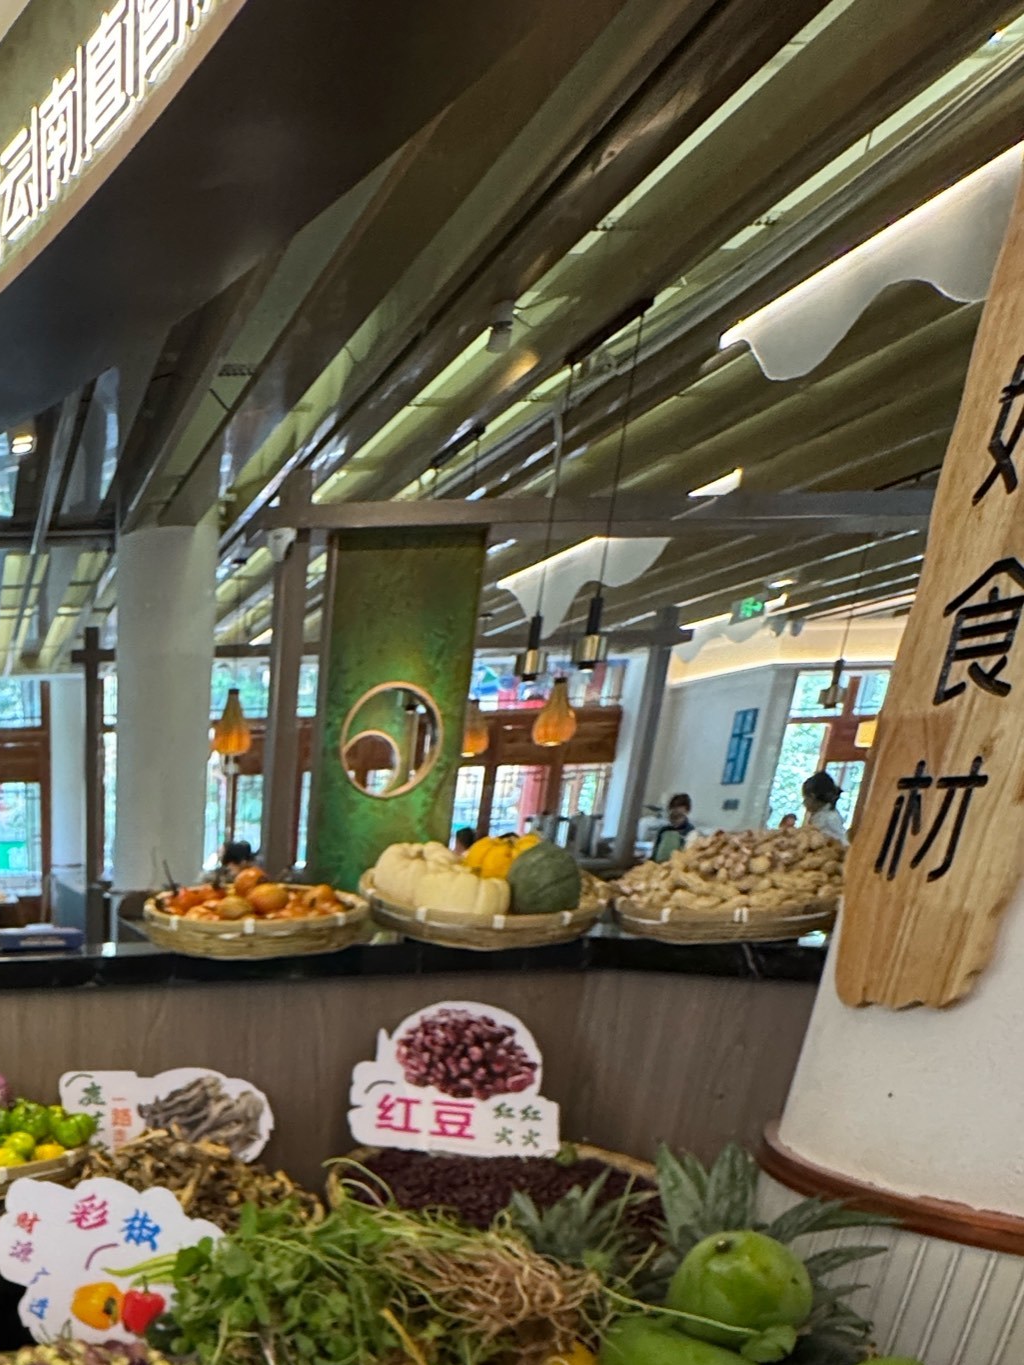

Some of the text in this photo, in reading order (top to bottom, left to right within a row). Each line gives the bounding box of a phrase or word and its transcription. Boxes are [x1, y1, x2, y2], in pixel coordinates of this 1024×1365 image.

[375, 1094, 476, 1139] 红豆
[494, 1126, 540, 1149] 火火
[67, 1193, 161, 1252] 彩椒
